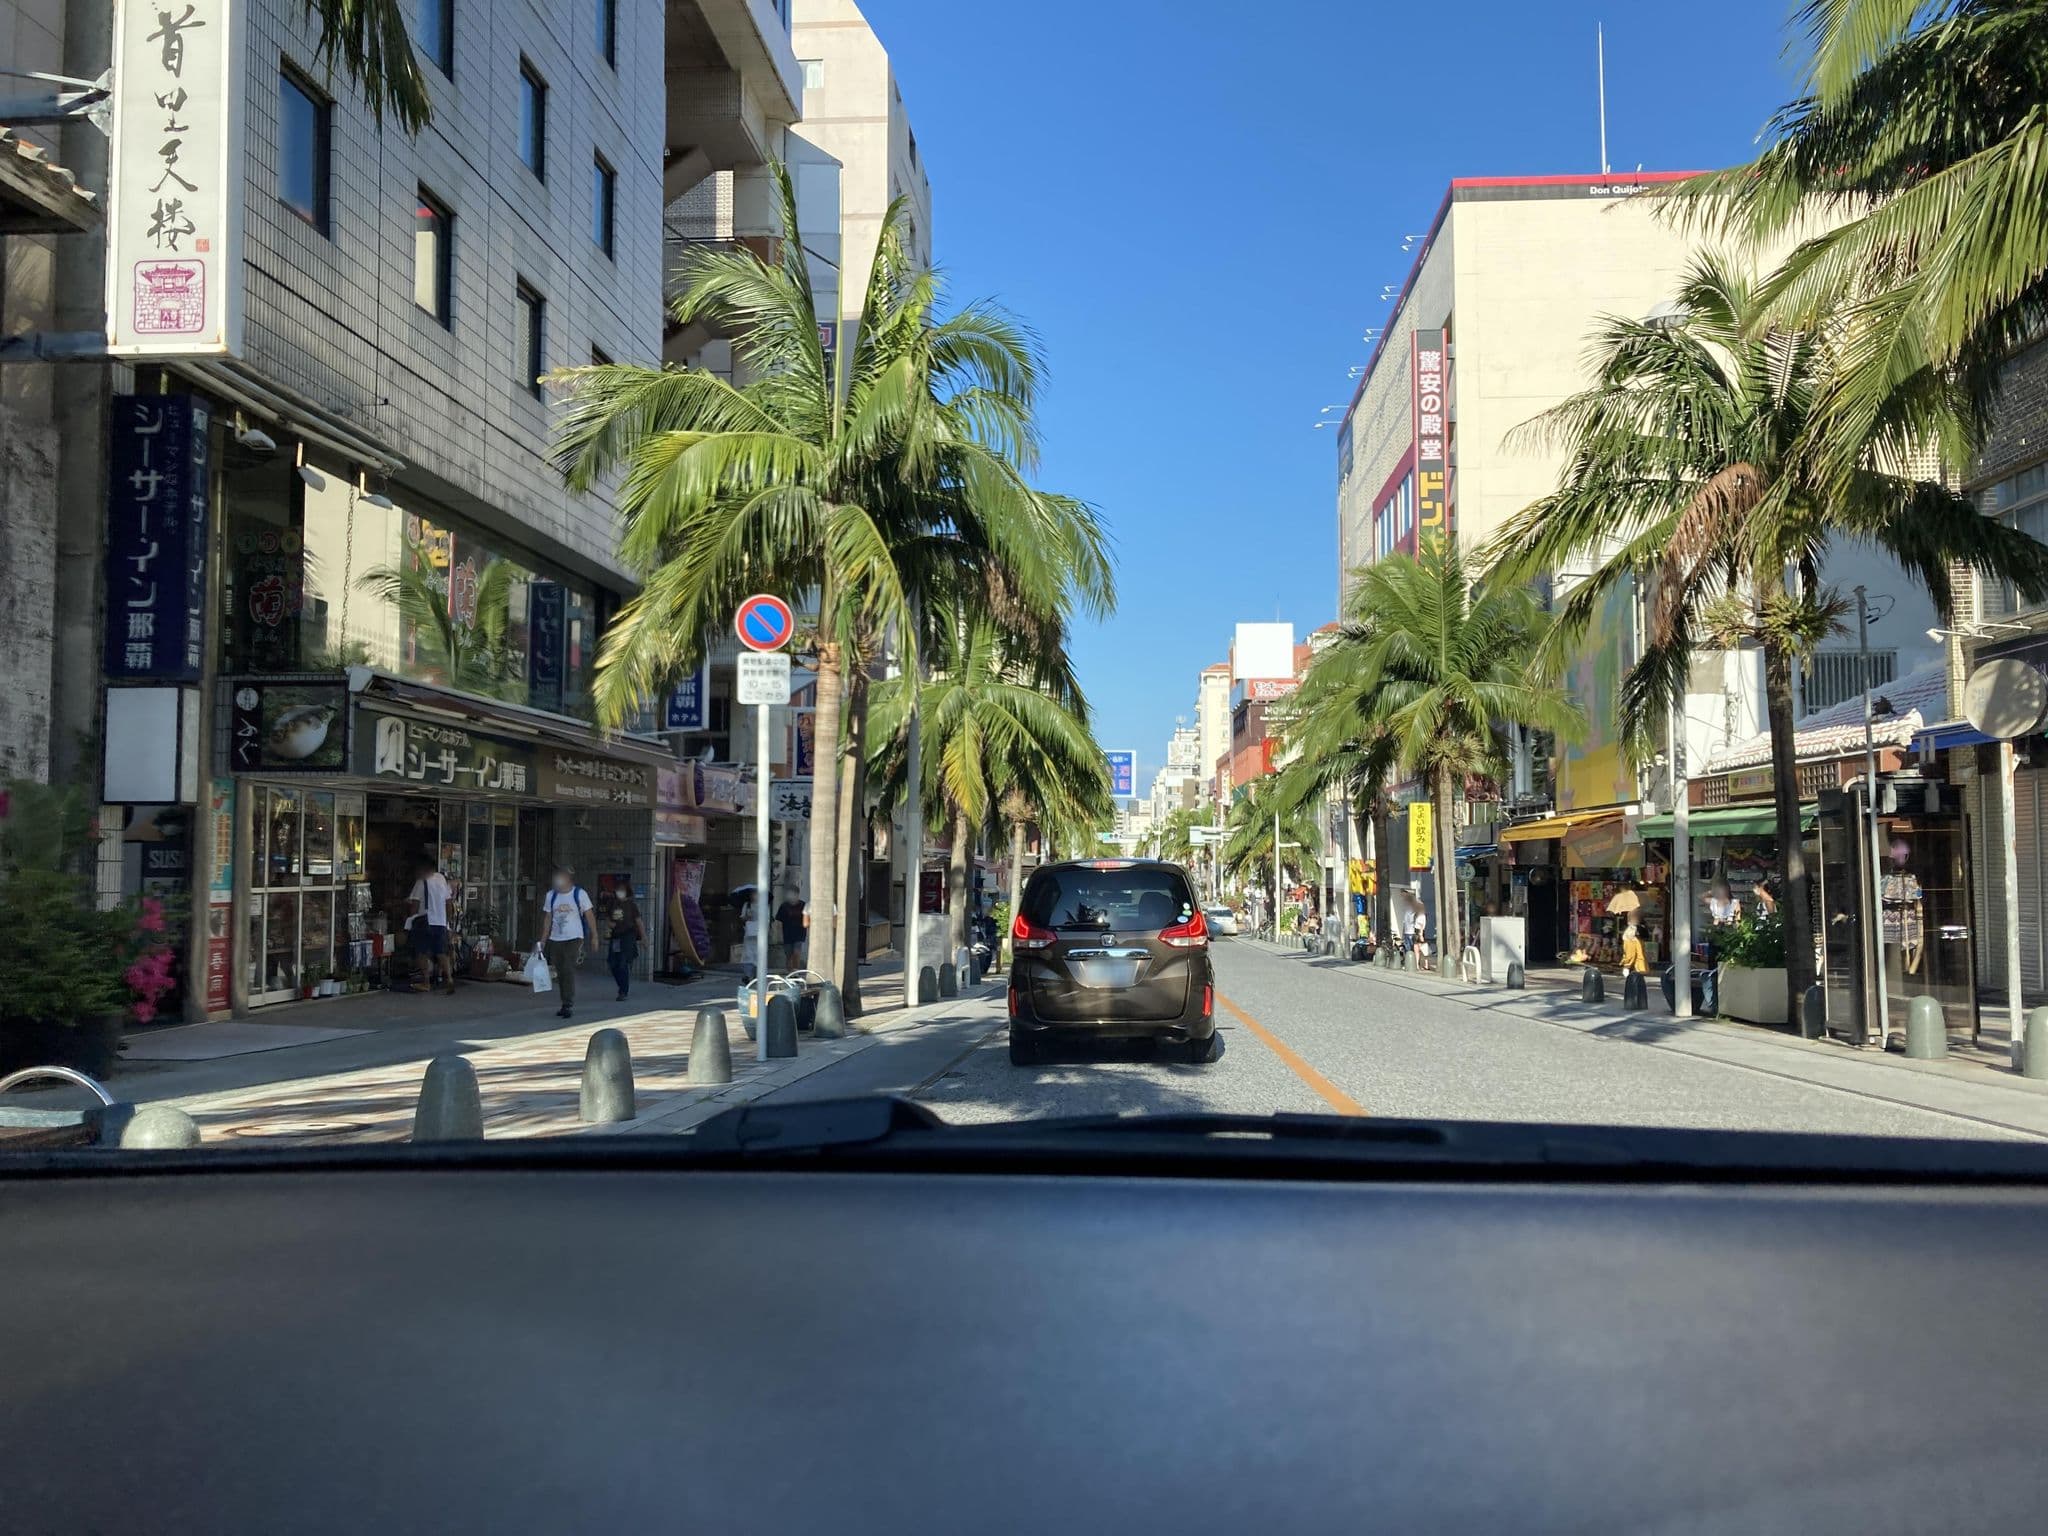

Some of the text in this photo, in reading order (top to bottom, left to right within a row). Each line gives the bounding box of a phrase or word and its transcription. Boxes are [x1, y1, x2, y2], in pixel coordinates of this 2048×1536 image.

[146, 4, 207, 251] 首里天楼
[1589, 186, 1610, 195] Don
[1418, 351, 1443, 461] 驚安の殿堂
[124, 402, 164, 669] シーサーイン那覇
[671, 713, 698, 721] ホテル
[407, 743, 526, 793] シーサーイン那覇
